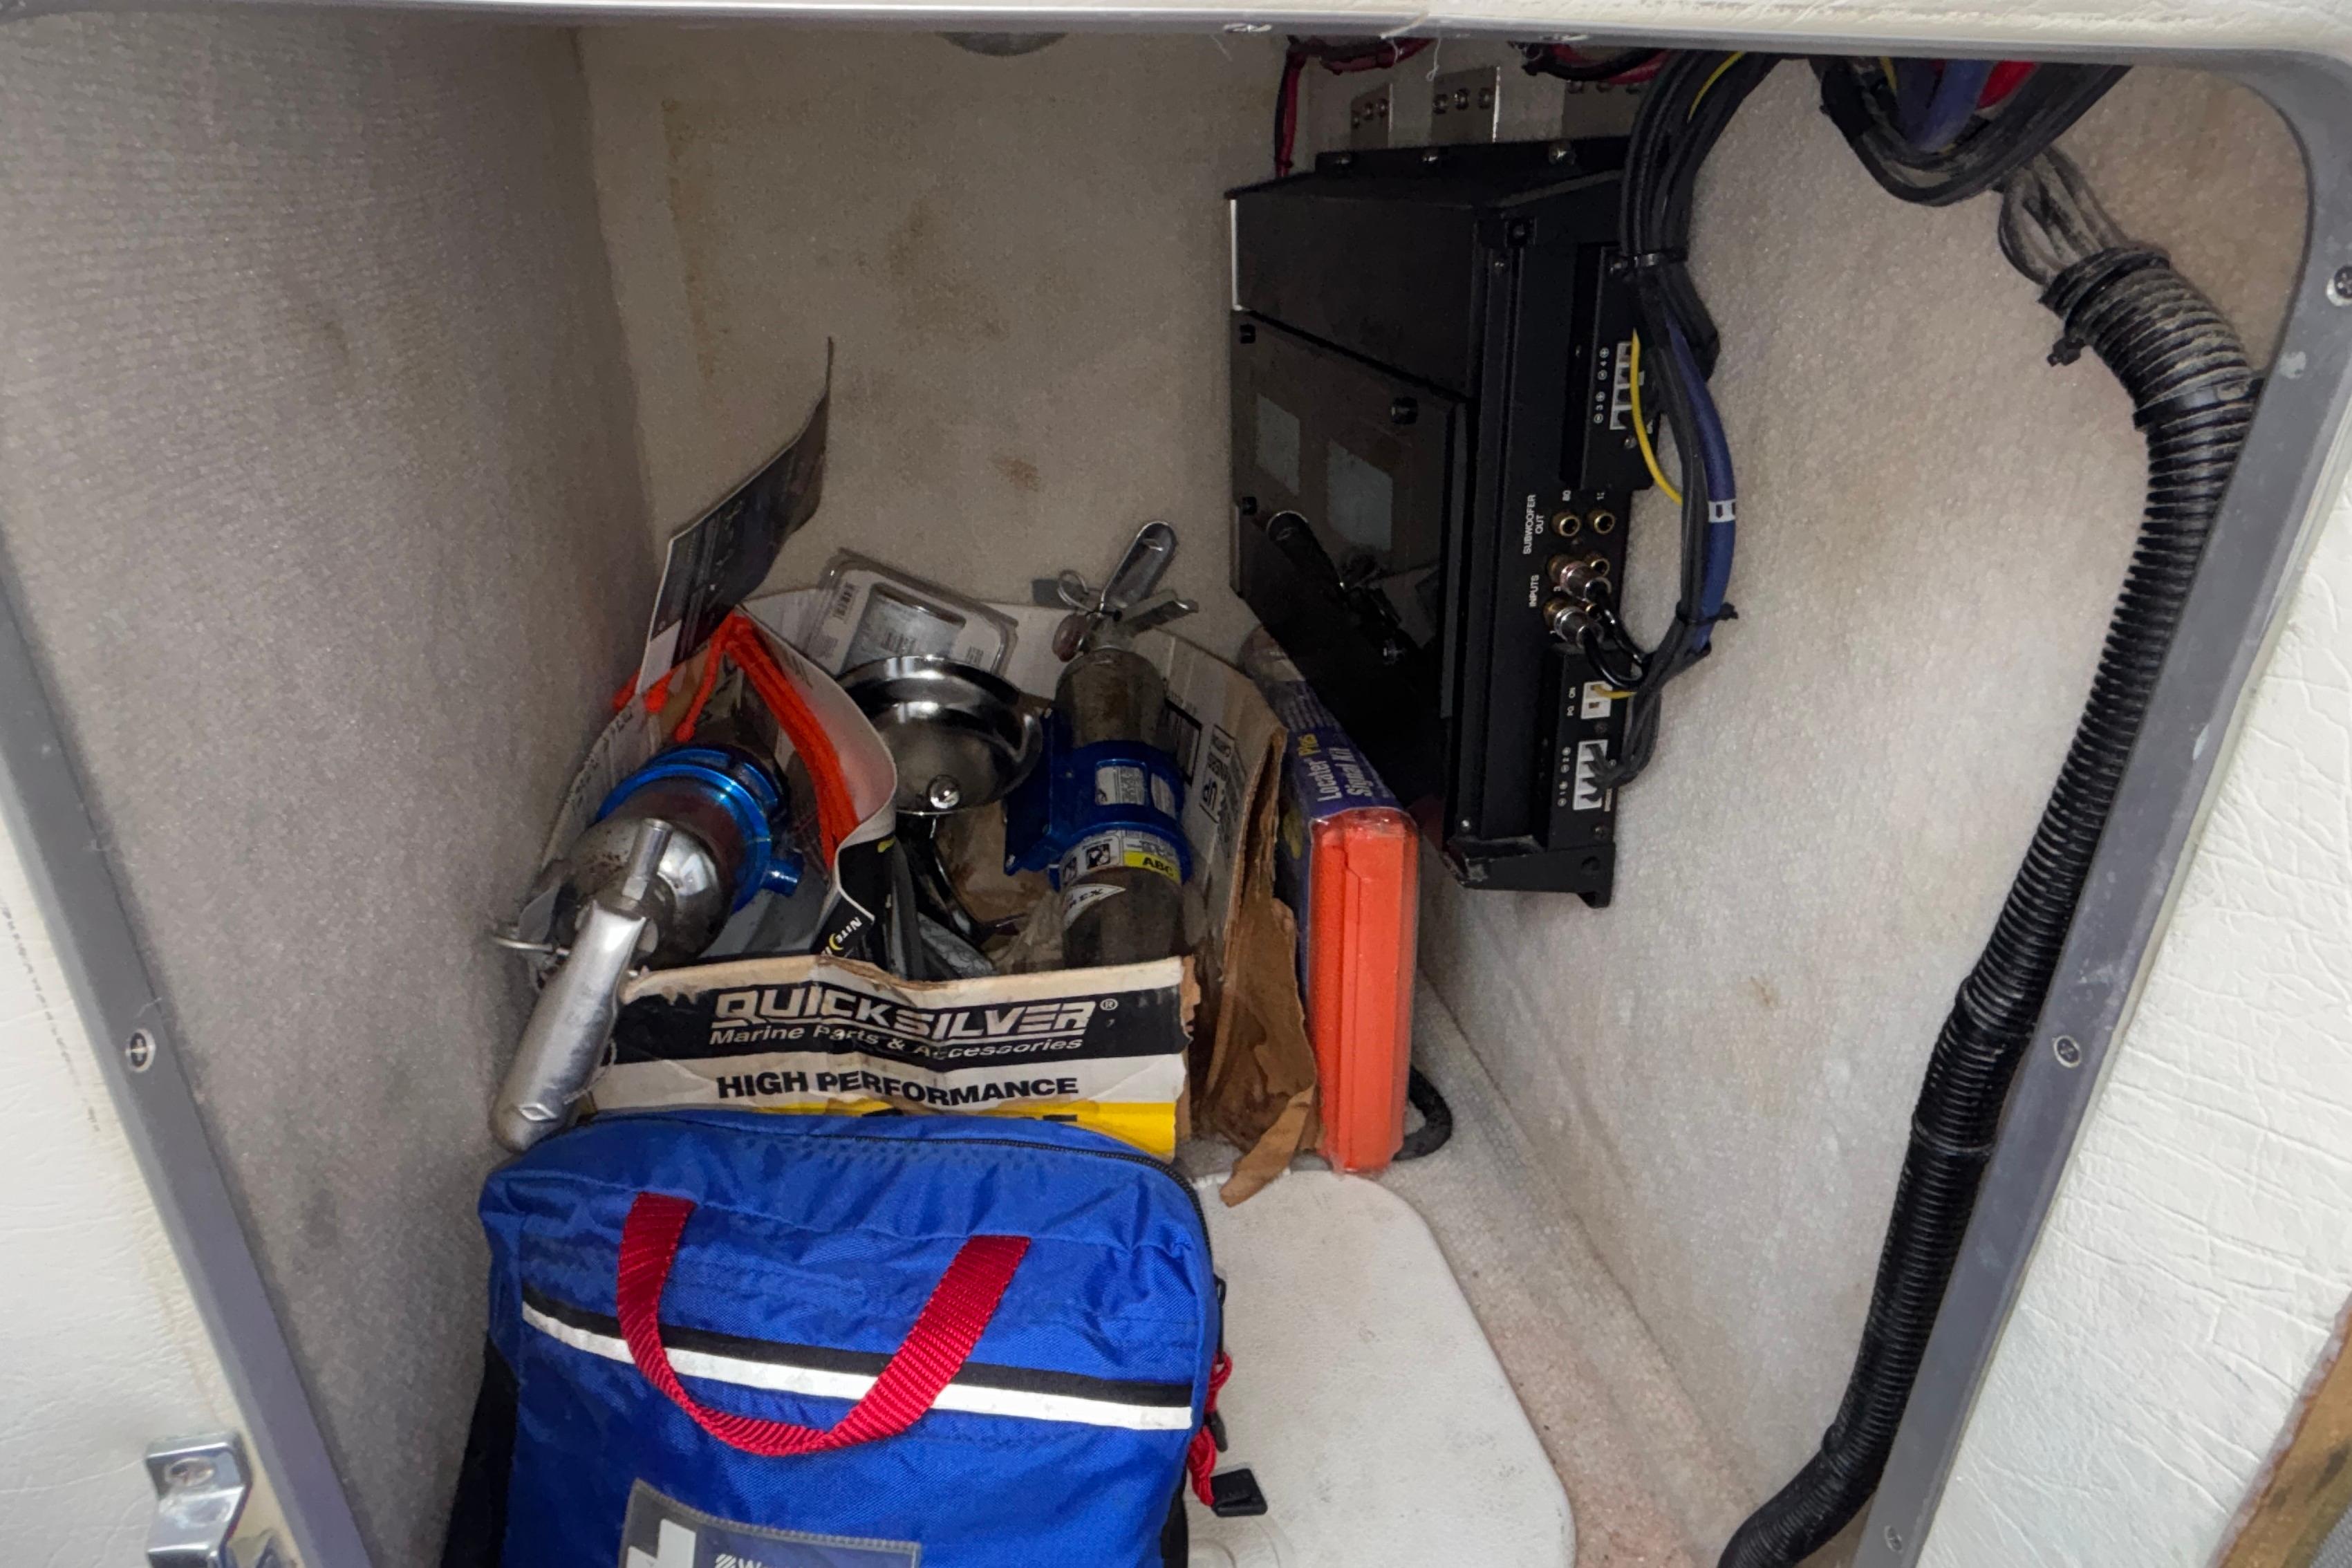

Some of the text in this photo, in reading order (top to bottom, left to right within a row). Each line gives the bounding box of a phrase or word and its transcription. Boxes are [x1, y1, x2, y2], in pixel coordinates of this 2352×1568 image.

[1522, 494, 1536, 554] SUBWOOFER
[1534, 514, 1544, 534] OUT
[1529, 574, 1540, 608] INPUTS
[1304, 758, 1343, 802] Locater
[1334, 763, 1374, 797] Signal
[1142, 857, 1174, 877] ABC
[835, 917, 863, 944] NITE
[710, 1023, 1084, 1060] Marine Parts & Accessories
[717, 1070, 1079, 1107] HIGH PERFORMANCE
